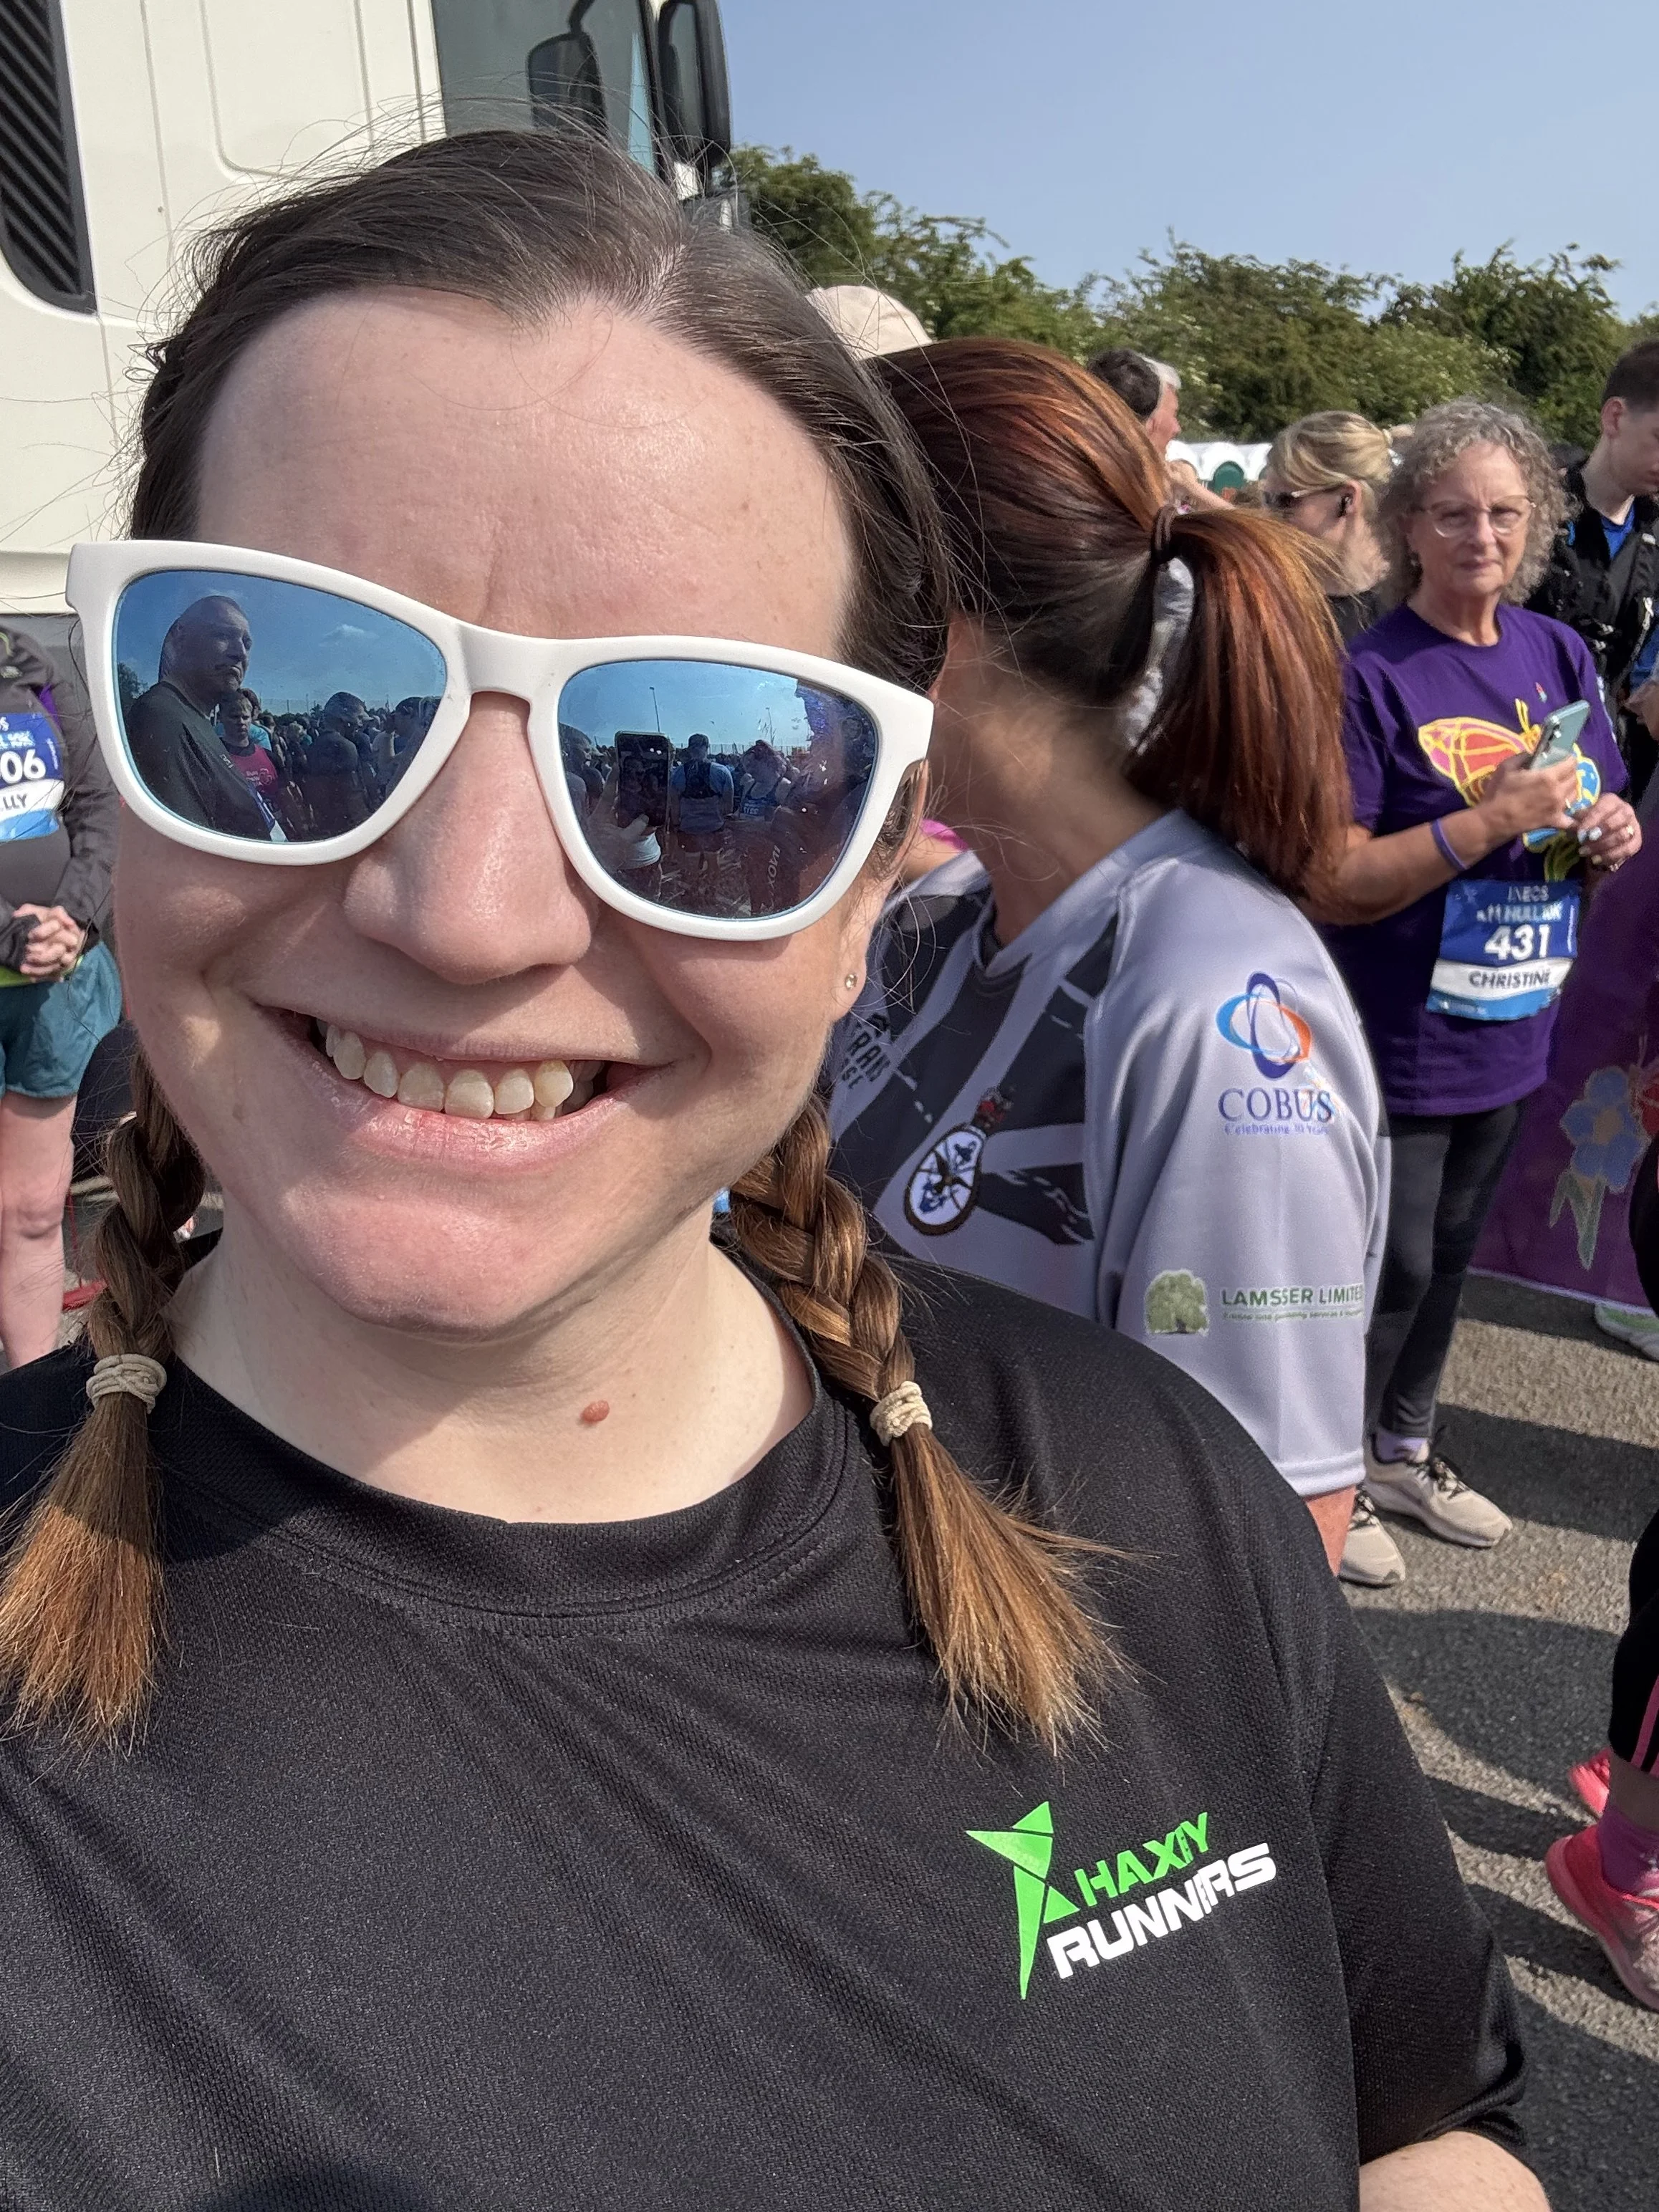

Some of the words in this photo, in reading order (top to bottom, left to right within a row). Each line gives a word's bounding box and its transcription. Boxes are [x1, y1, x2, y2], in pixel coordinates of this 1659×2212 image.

[0, 794, 28, 810] LLY
[1485, 923, 1550, 961] 431
[1218, 1087, 1333, 1123] COBUS
[1221, 1287, 1314, 1306] LAMSSER
